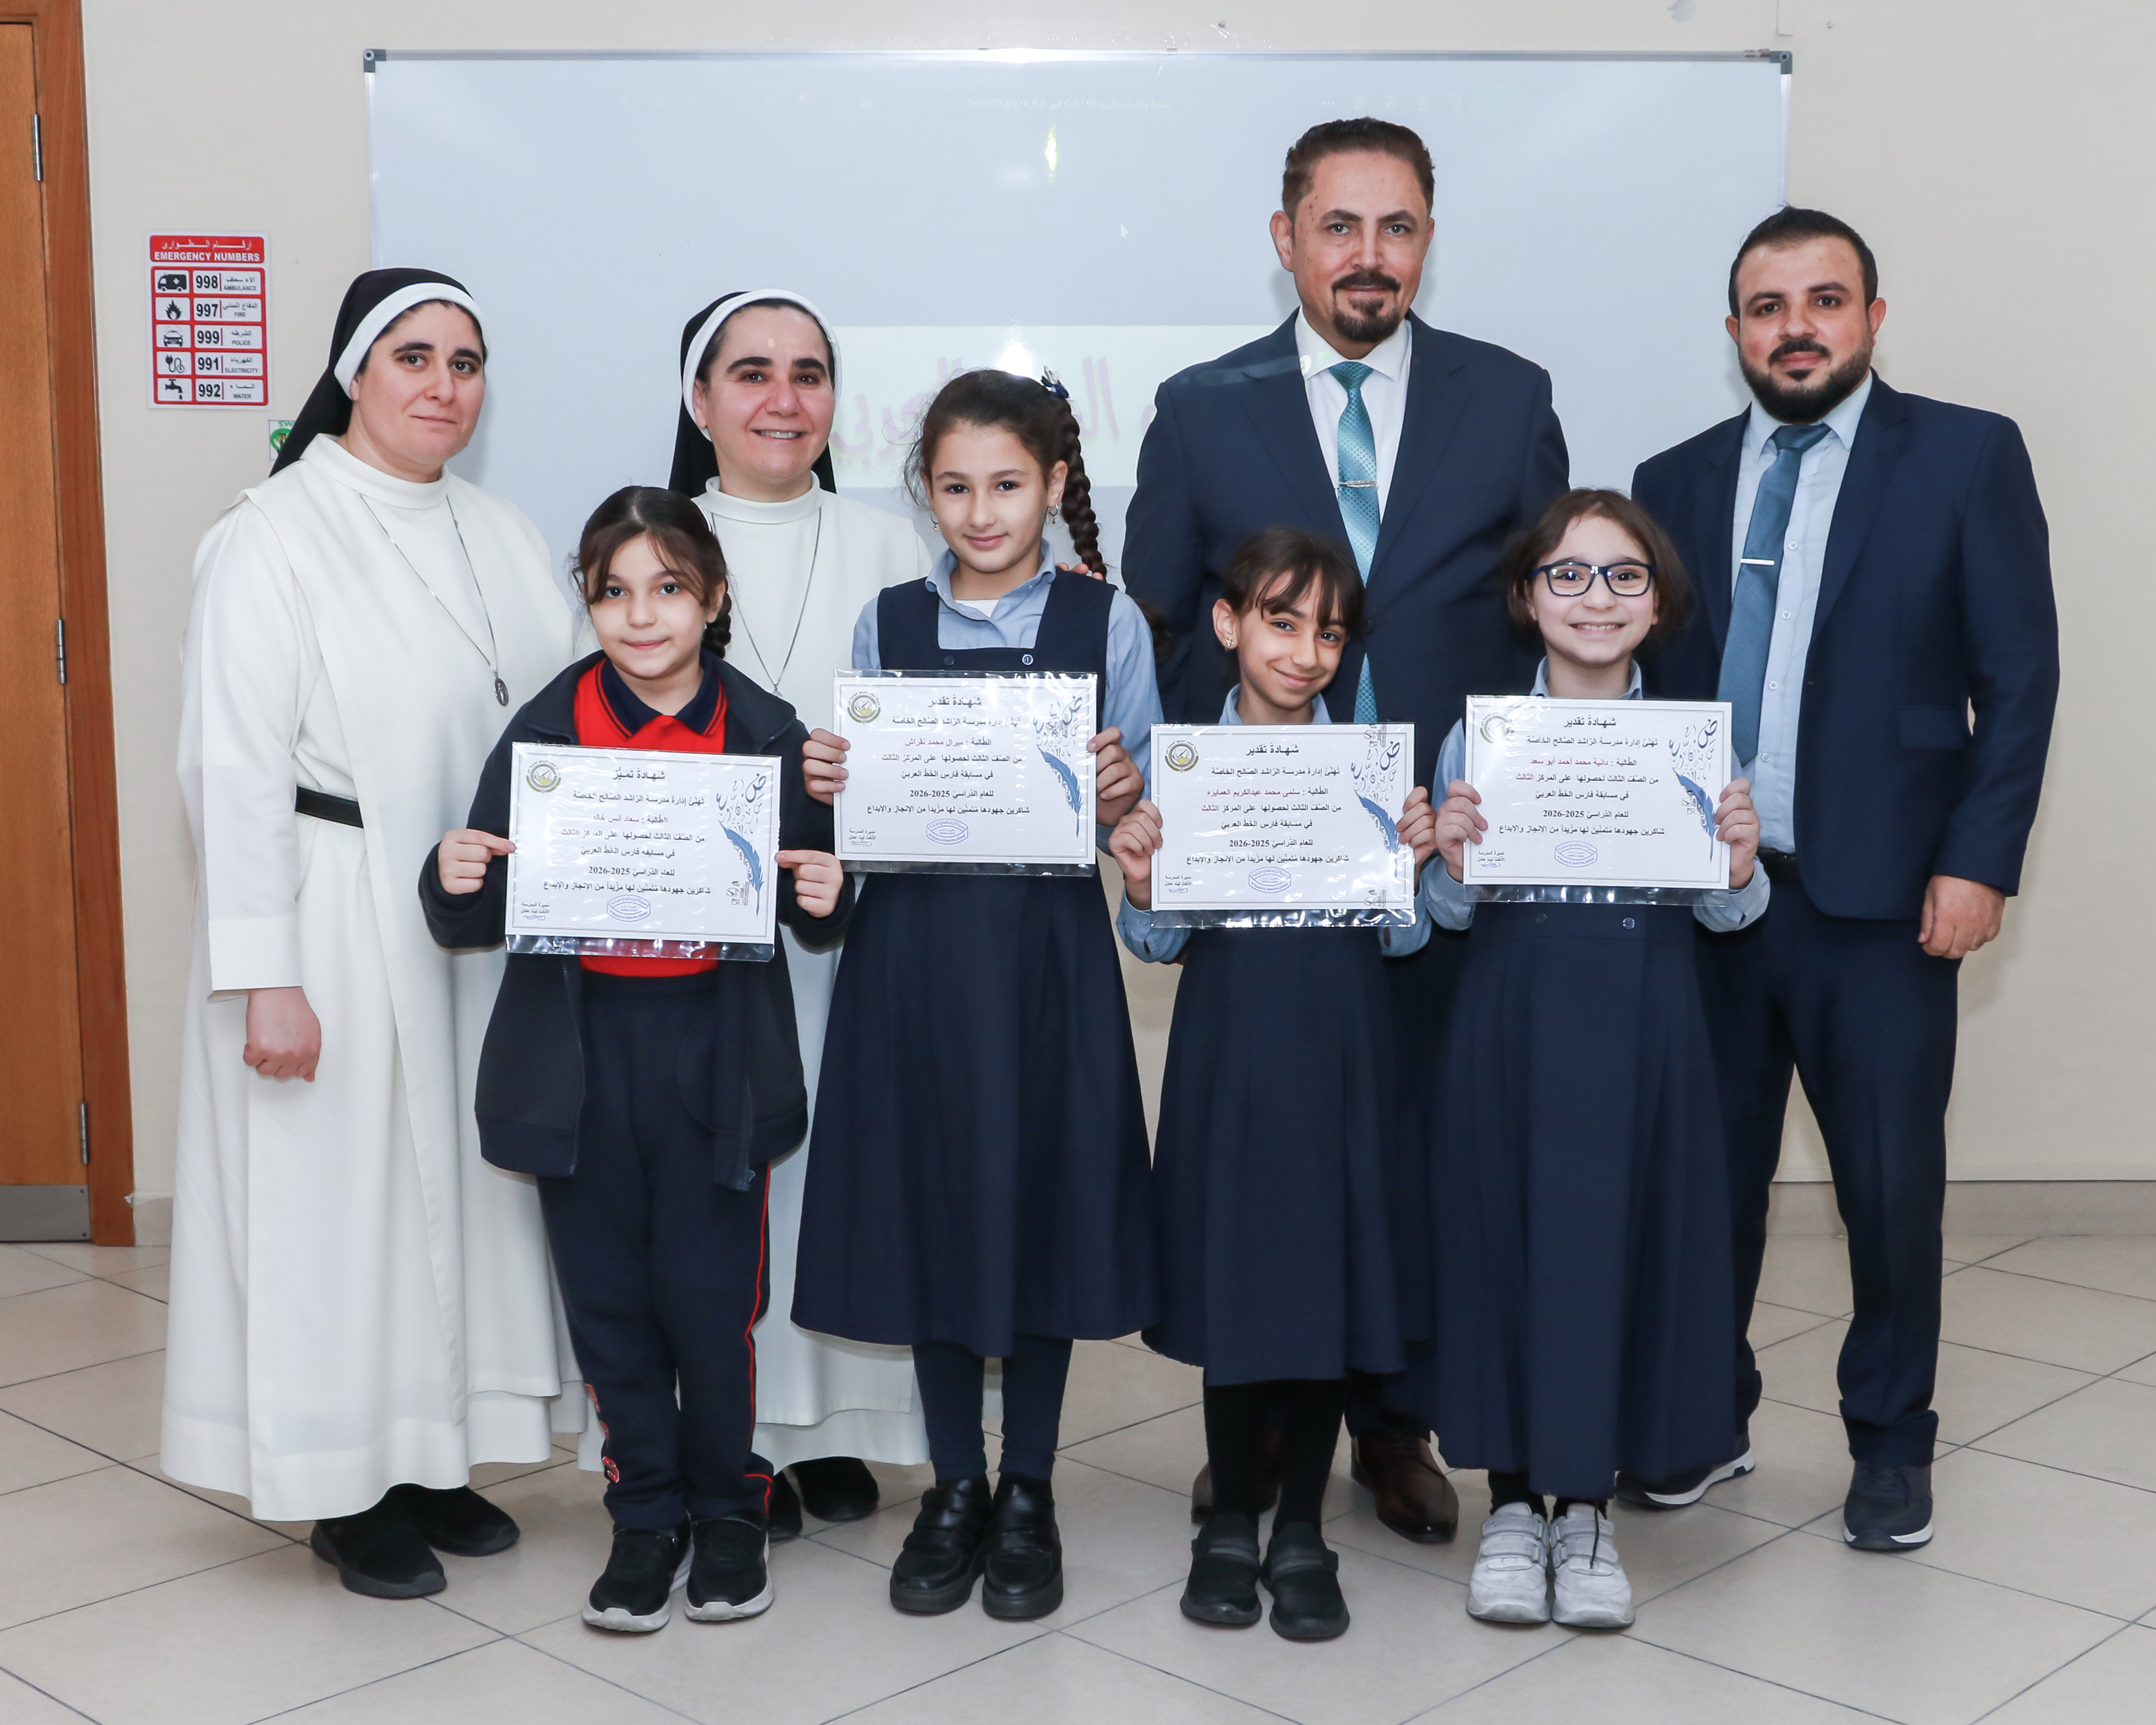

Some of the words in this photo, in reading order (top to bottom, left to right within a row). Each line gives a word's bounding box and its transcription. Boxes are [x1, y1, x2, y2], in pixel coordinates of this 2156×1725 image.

[154, 252, 211, 261] EMERGENCY
[214, 253, 259, 261] NUMBERS
[196, 275, 218, 289] 998
[196, 303, 218, 317] 997
[197, 331, 219, 344] 999
[198, 357, 218, 370] 991
[199, 384, 221, 397] 992
